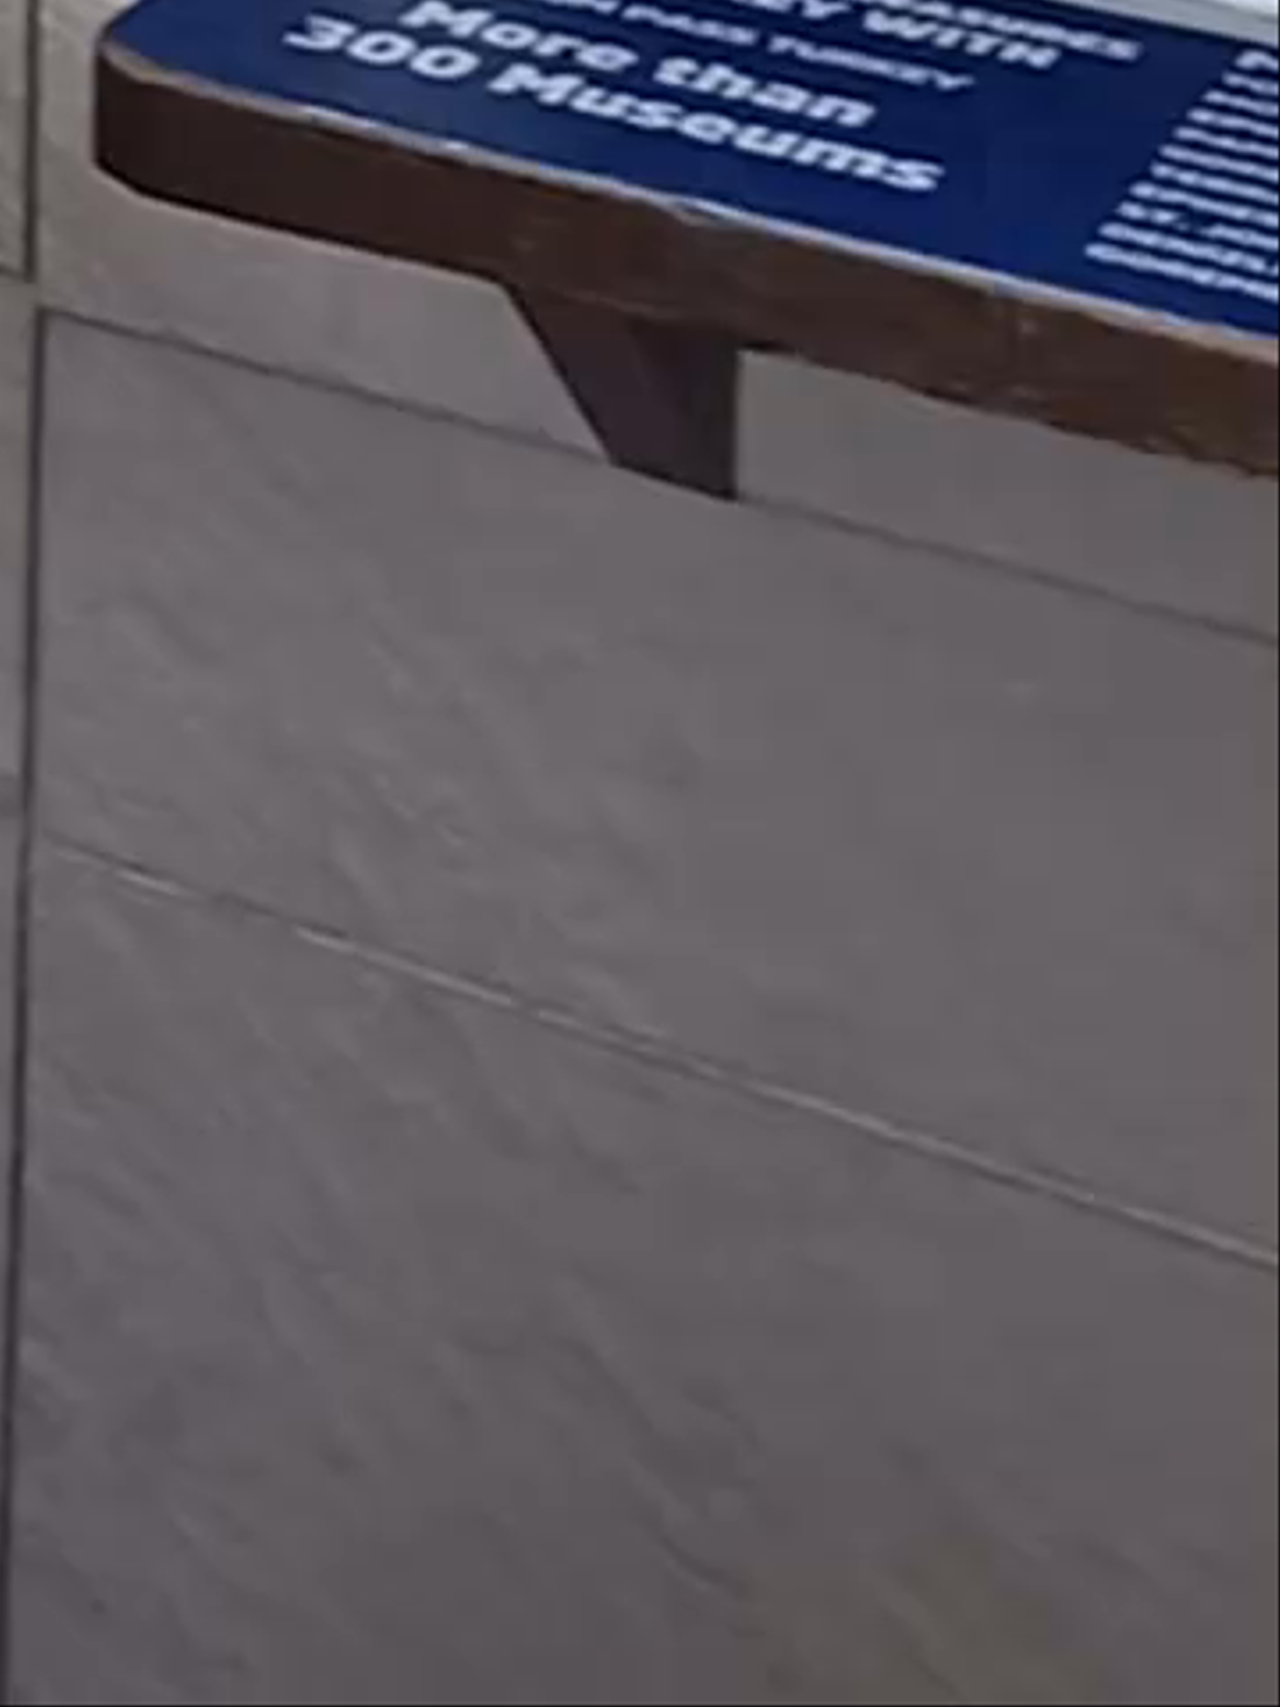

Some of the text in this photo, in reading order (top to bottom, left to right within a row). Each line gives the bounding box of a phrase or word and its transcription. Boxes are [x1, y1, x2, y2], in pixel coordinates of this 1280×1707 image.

[861, 10, 1061, 69] WITH
[282, 13, 945, 193] 300 Museums
[653, 56, 876, 129] than
